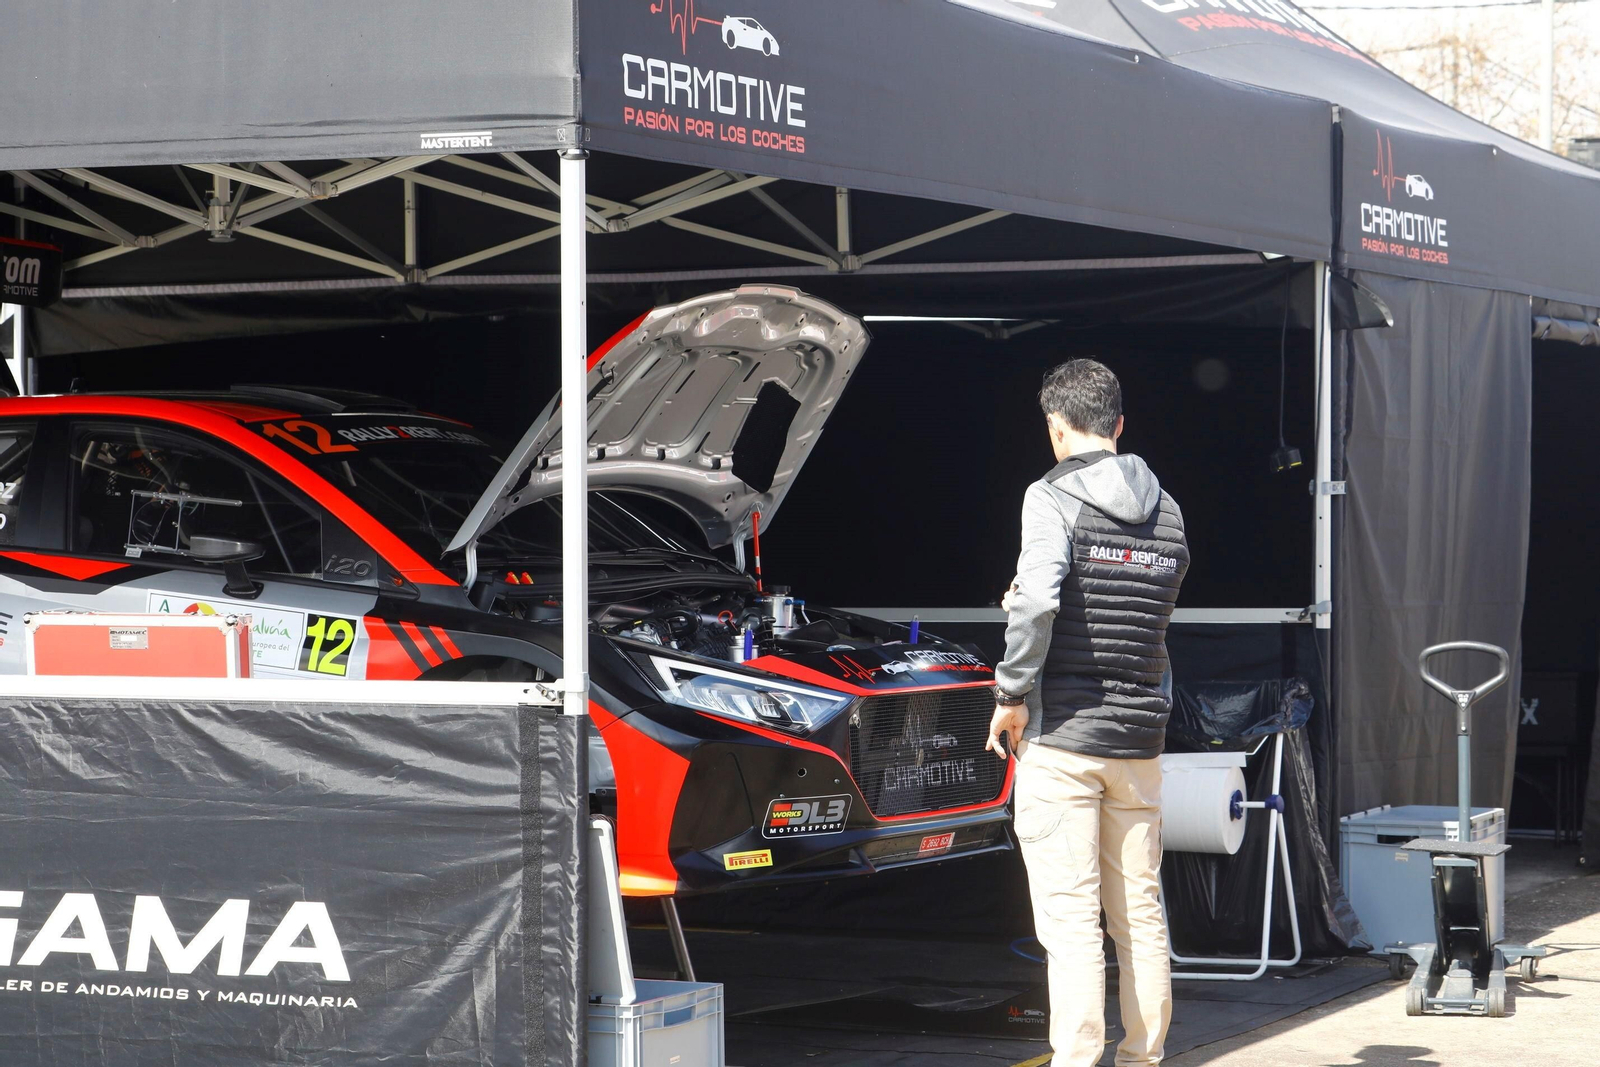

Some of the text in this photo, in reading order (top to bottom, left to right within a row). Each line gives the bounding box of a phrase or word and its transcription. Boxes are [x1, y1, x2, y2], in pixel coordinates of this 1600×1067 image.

[622, 53, 806, 128] CARMOTIVE
[624, 106, 805, 154] PASIÓN POR LOS COCHES
[1361, 202, 1448, 247] CARMOTIVE
[1362, 237, 1449, 265] PASIÓN POR LOS COCHES
[3, 256, 41, 285] om
[262, 420, 359, 455] 12
[1090, 545, 1177, 567] RALLY2RENT.com
[306, 617, 354, 676] 12
[884, 758, 977, 790] CARMOTIVE
[769, 823, 842, 834] MOTORSPORT
[772, 810, 802, 819] WORKS
[728, 853, 769, 867] PIRELLI
[41, 981, 68, 994] DE
[75, 983, 190, 1001] ANDAMIOS
[197, 989, 211, 1002] Y
[217, 991, 359, 1009] MAQUINARIA
